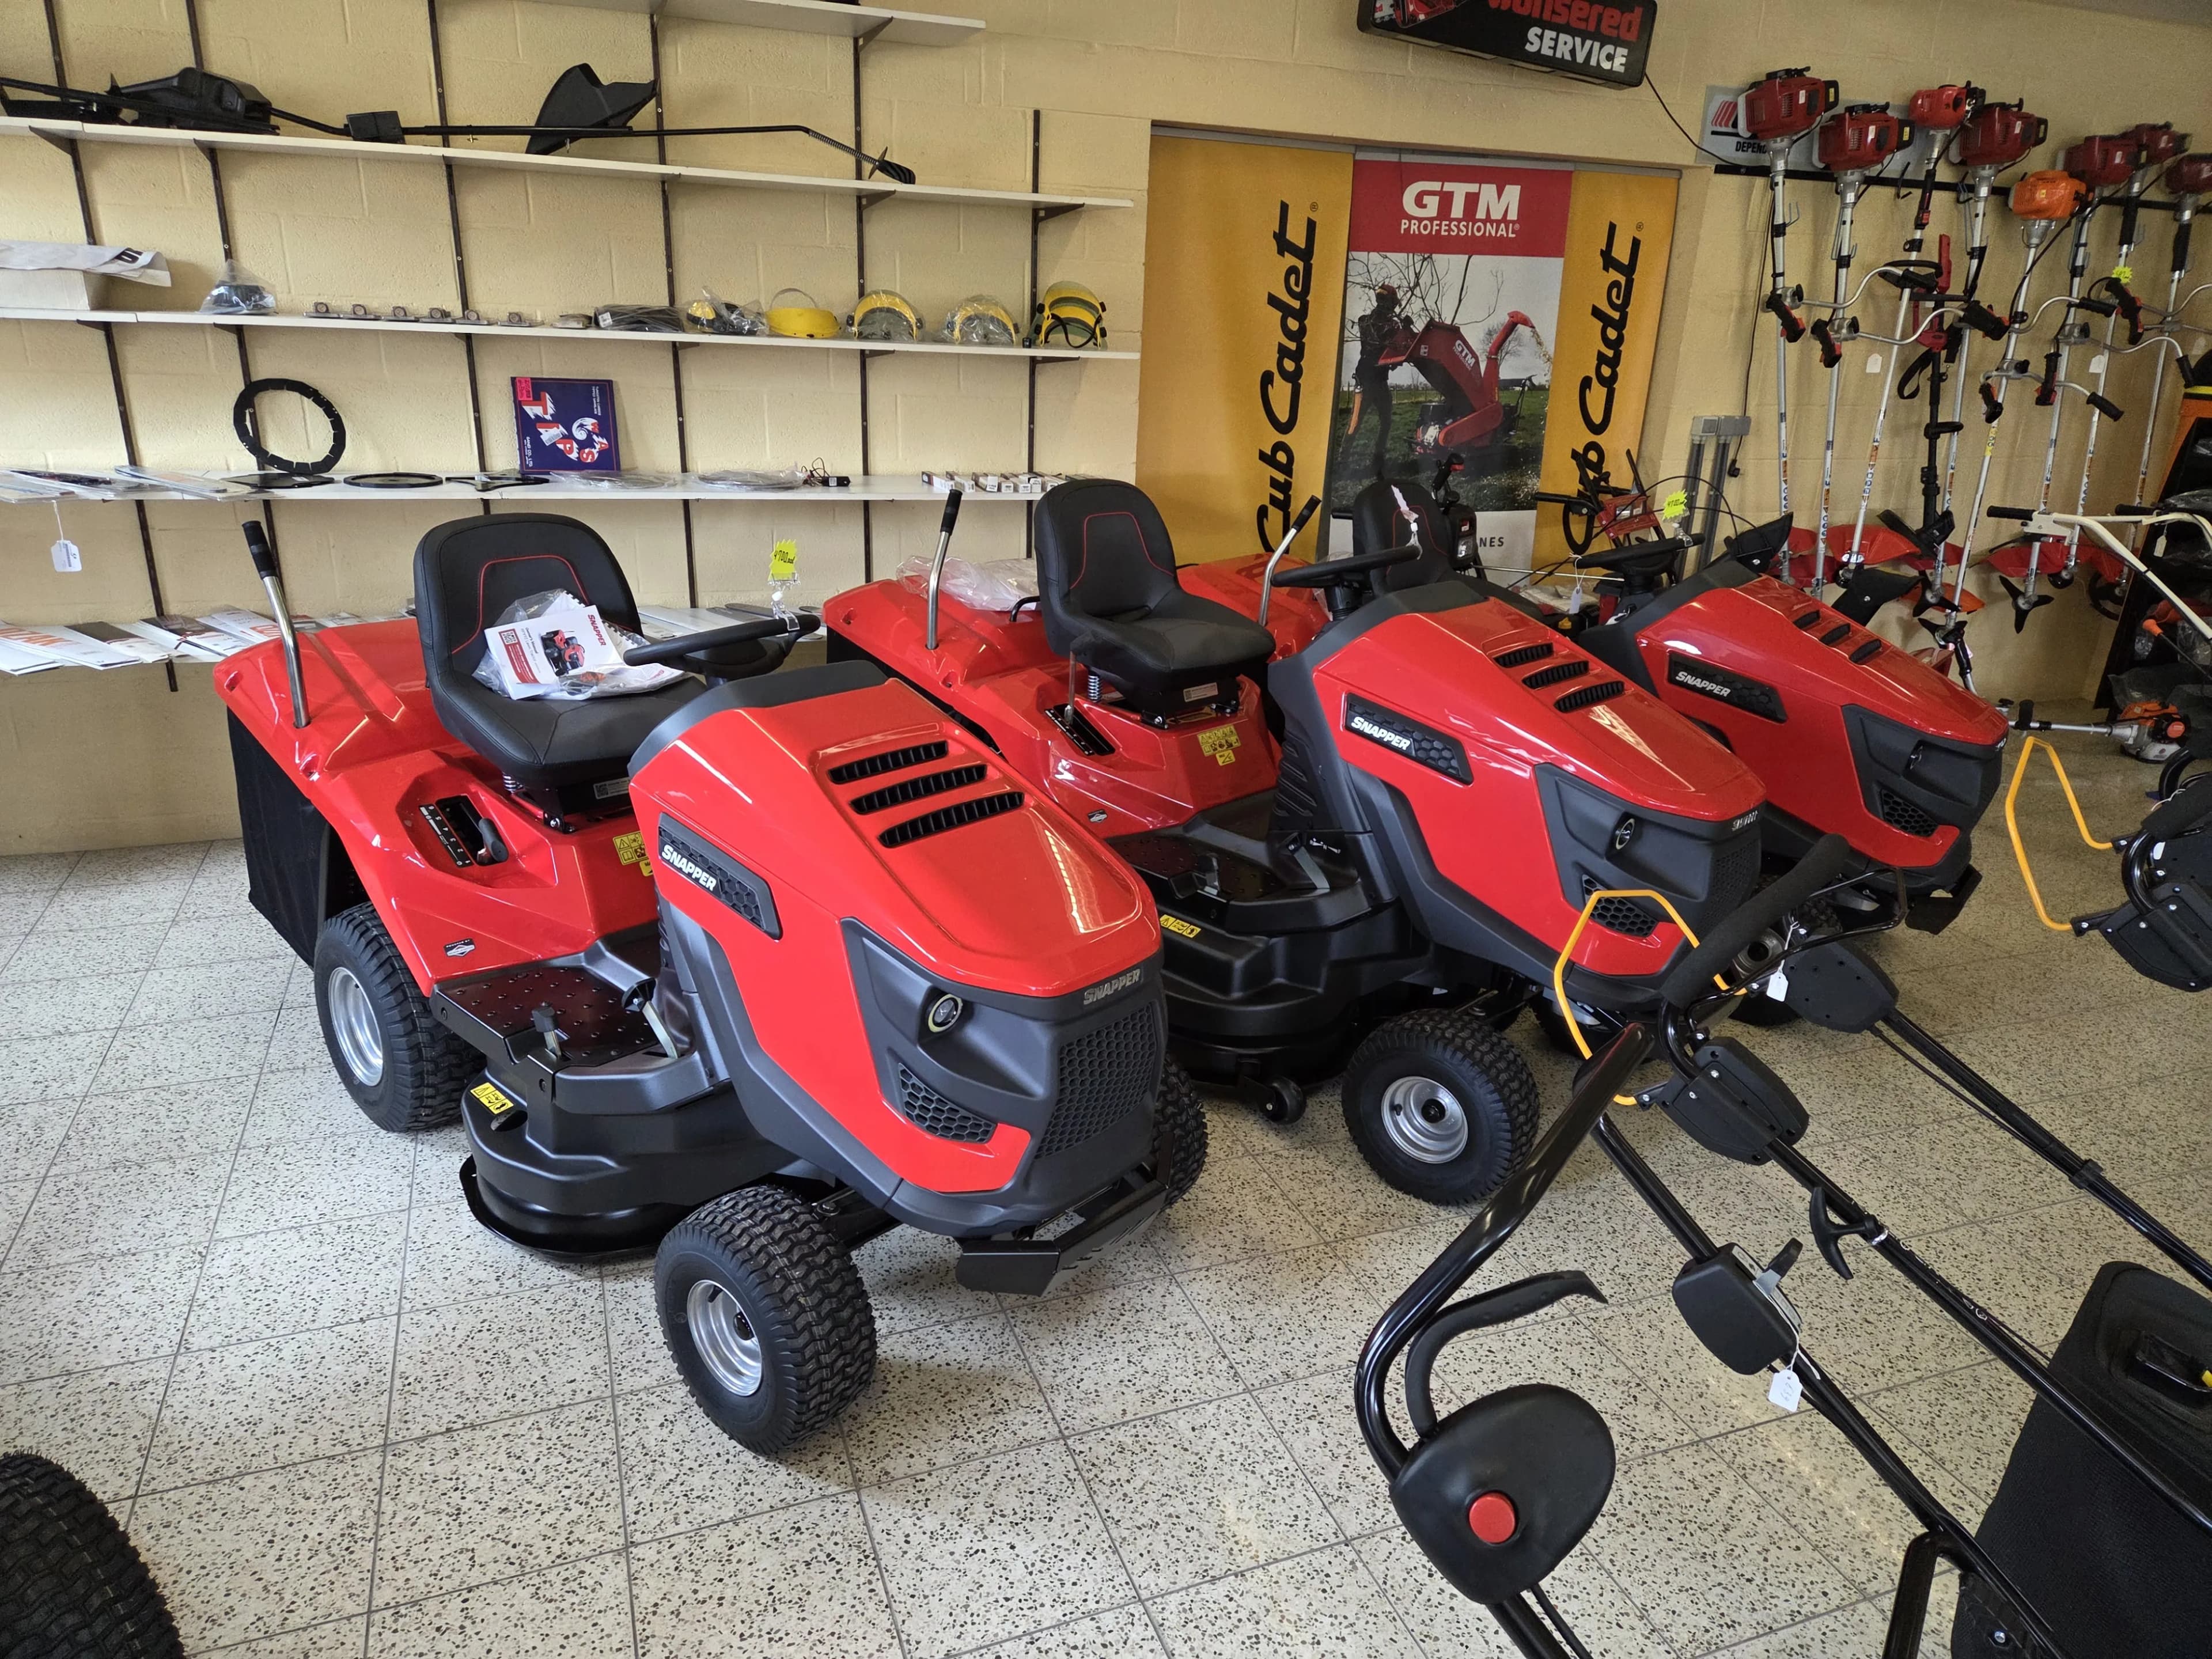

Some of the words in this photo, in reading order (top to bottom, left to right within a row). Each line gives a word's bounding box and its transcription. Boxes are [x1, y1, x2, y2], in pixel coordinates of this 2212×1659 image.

[1488, 0, 1643, 42] onsered
[1525, 26, 1628, 73] SERVICE
[1403, 181, 1521, 220] GTM
[1401, 219, 1516, 237] PROFESSIONAL
[1260, 199, 1317, 435] Cadet
[1579, 221, 1641, 435] Cadet
[1455, 339, 1475, 367] GTM
[1257, 441, 1294, 555] Cub
[588, 614, 607, 646] SNAPPER
[1675, 671, 1731, 697] SNAPPER
[1351, 716, 1411, 751] SNAPPER
[661, 844, 717, 892] SNAPPER
[1083, 968, 1141, 1005] SNAPPER
